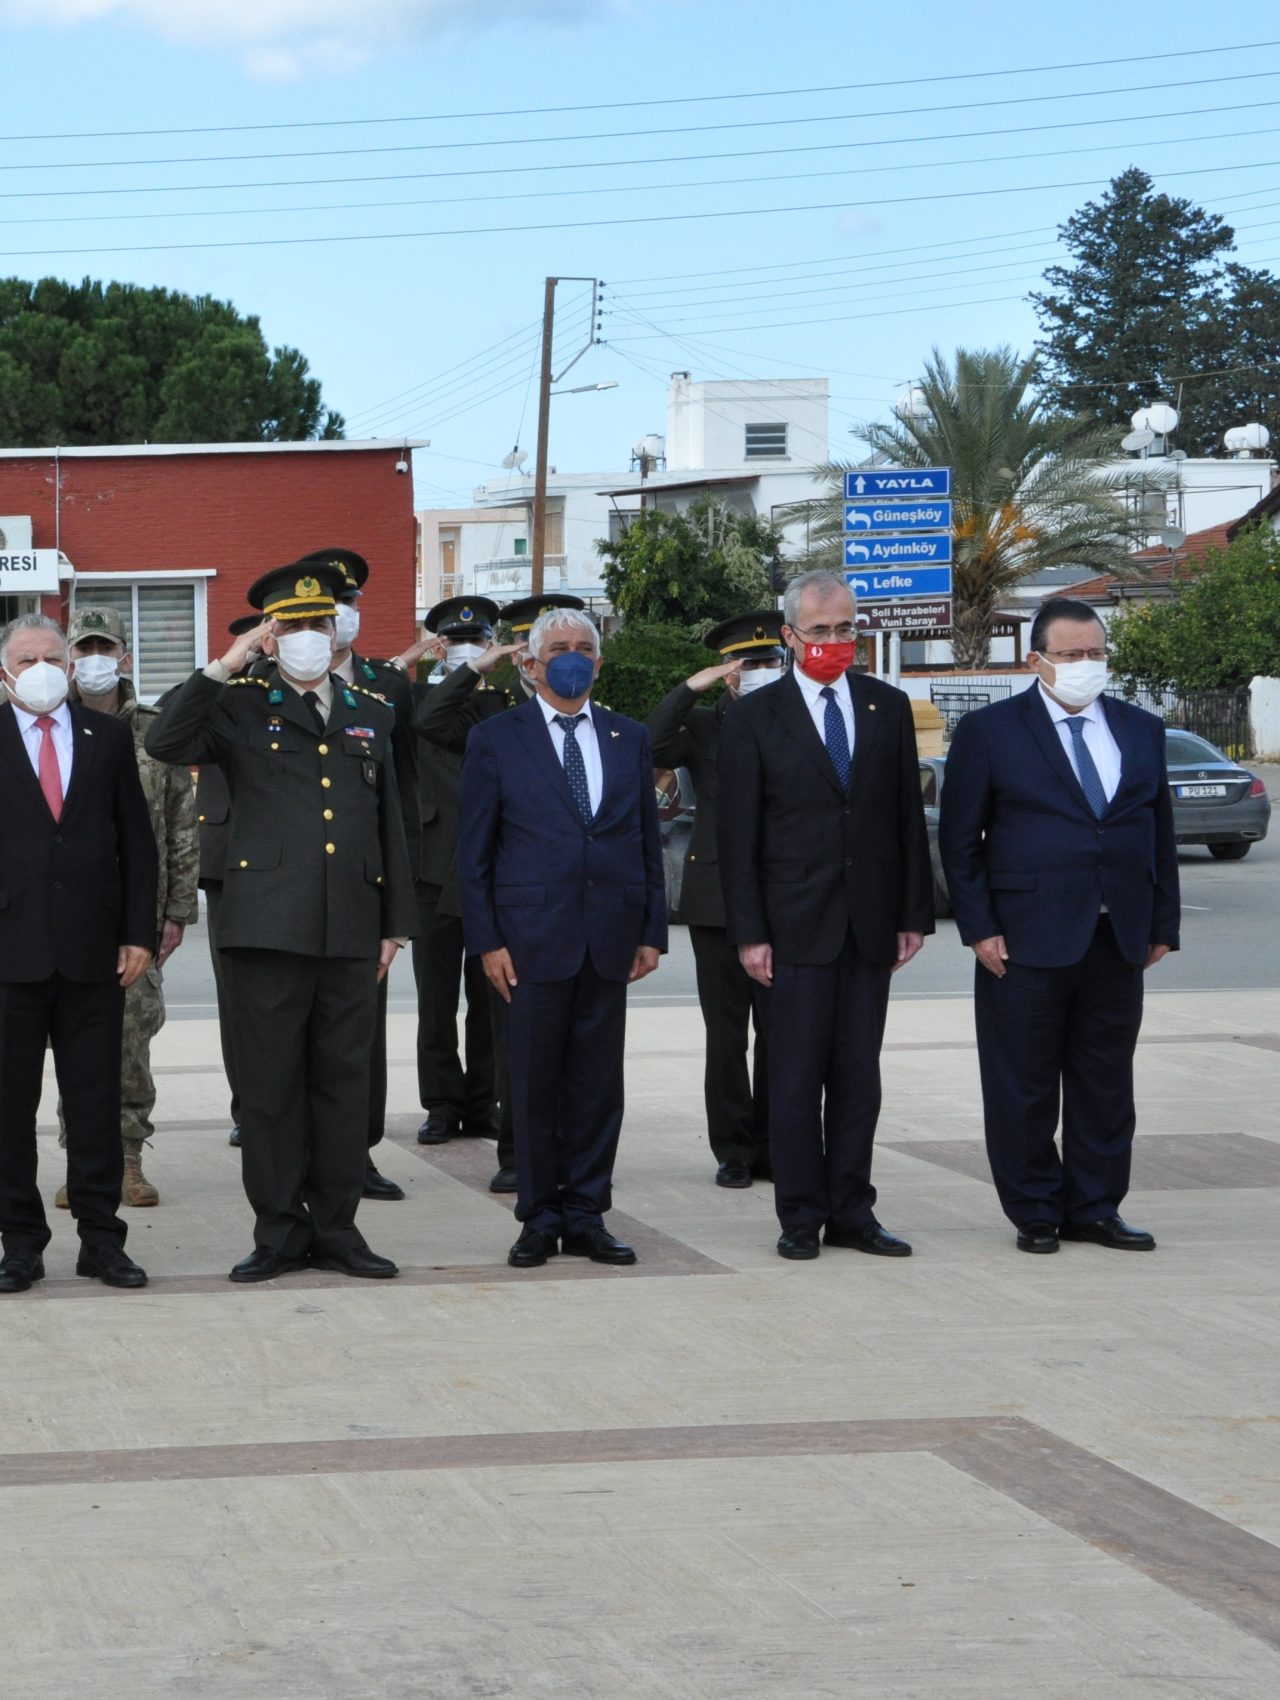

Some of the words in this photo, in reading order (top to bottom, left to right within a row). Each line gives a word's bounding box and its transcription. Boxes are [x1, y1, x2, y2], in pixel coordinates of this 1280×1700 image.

[875, 478, 934, 489] YAYLA
[873, 508, 942, 523] Güneşköy
[872, 541, 937, 558] Aydınköy
[873, 577, 912, 589] Lefke
[871, 608, 891, 618] Soli
[893, 604, 945, 616] Harabeleri
[880, 617, 903, 628] Vuni
[905, 616, 936, 627] Sarayı
[1202, 786, 1218, 795] 121
